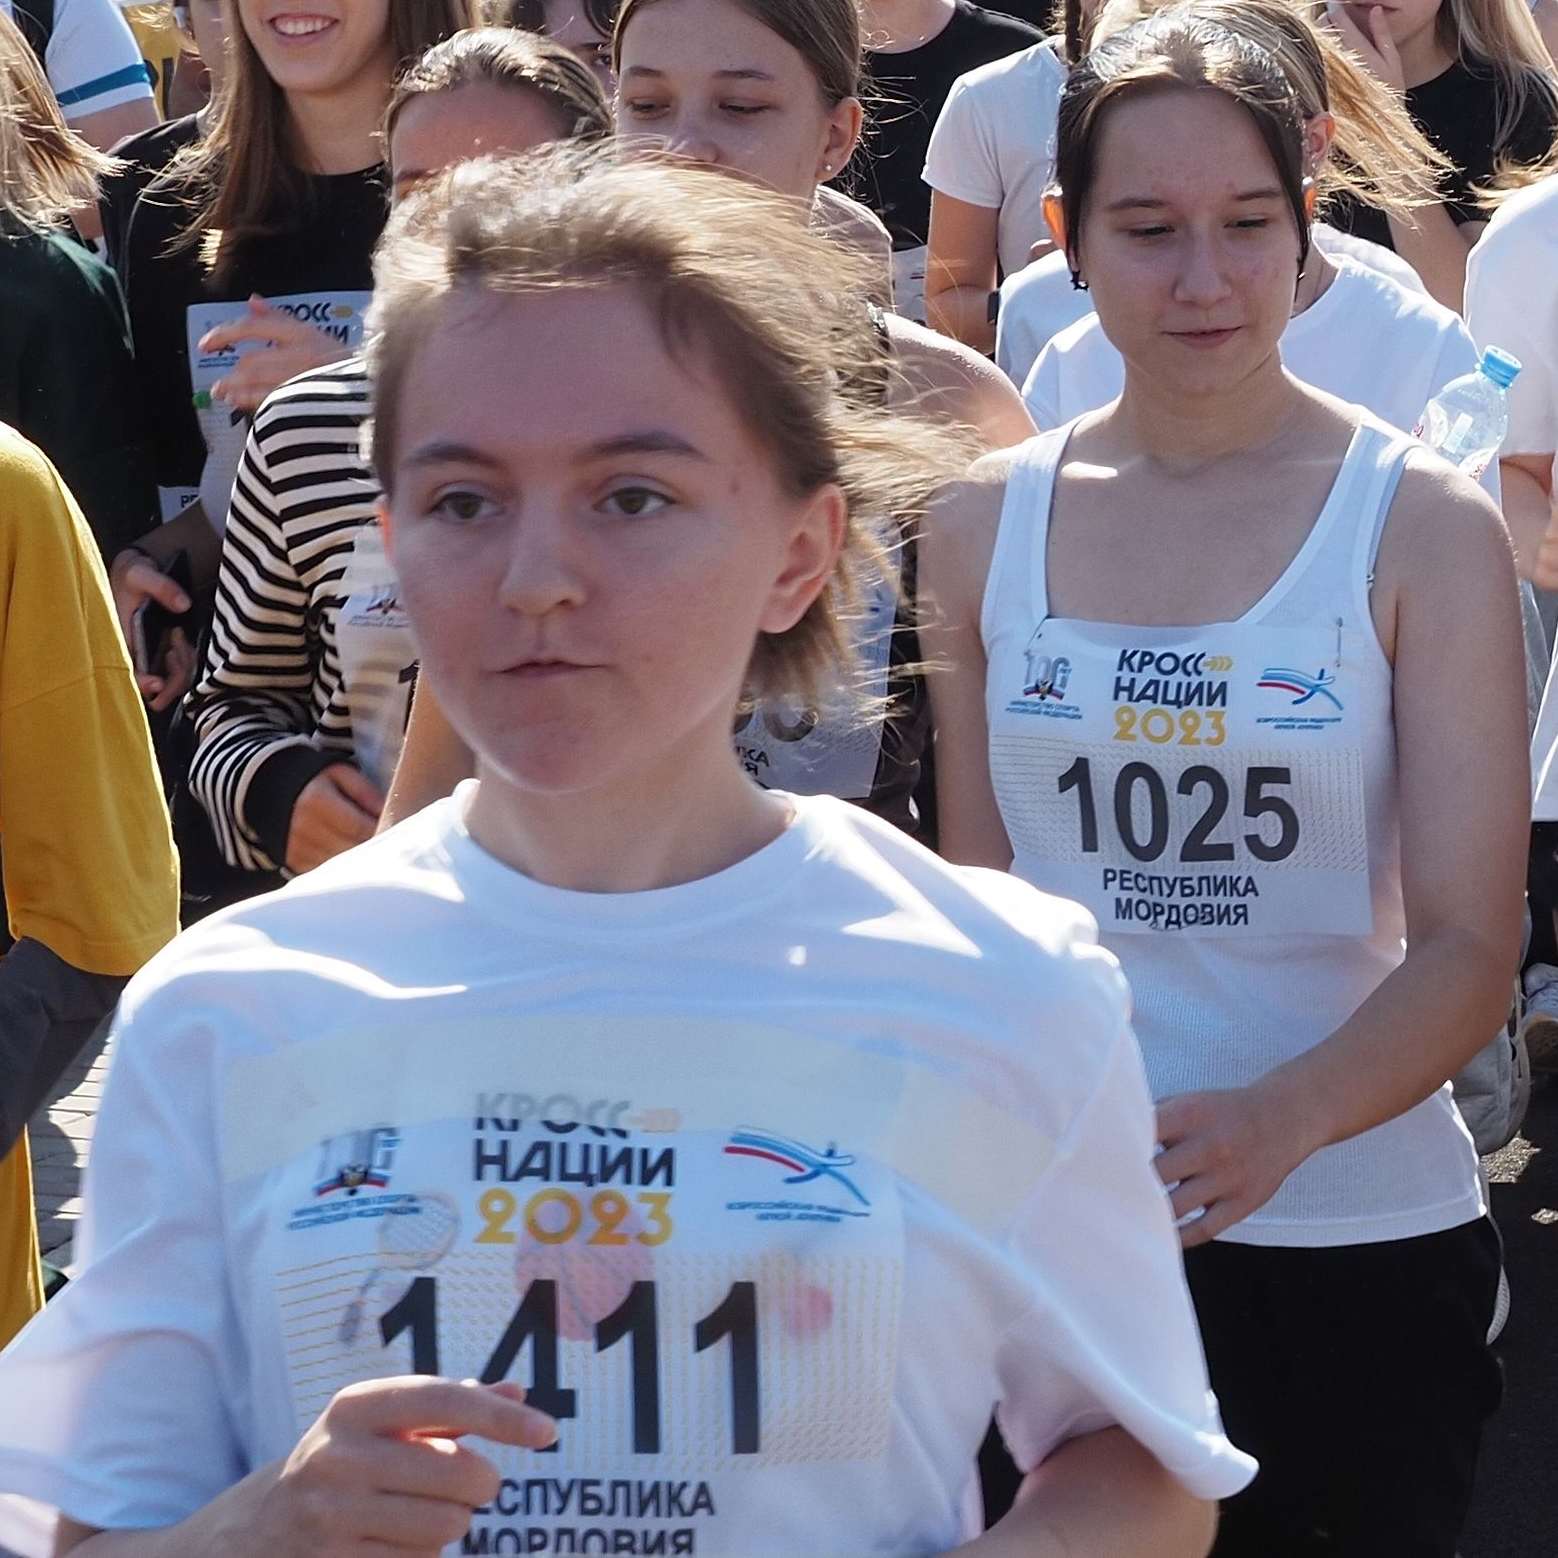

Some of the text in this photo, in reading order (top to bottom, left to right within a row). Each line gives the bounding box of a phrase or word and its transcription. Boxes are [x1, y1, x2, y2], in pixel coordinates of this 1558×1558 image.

[276, 303, 331, 322] РОСС
[1117, 649, 1207, 678] КРОСС
[1112, 676, 1228, 709] НАЦИИ
[1112, 706, 1227, 748] 2023
[1057, 757, 1300, 863] 1025
[1103, 869, 1259, 898] РЕСПУБЛИКА
[1114, 897, 1249, 930] МОРДОВИЯ
[475, 1092, 632, 1140] КРОСС
[473, 1138, 676, 1189] НАЦИИ
[472, 1187, 675, 1248] 2023
[379, 1276, 763, 1456] 1411
[474, 1478, 716, 1519] СПУБЛИКА
